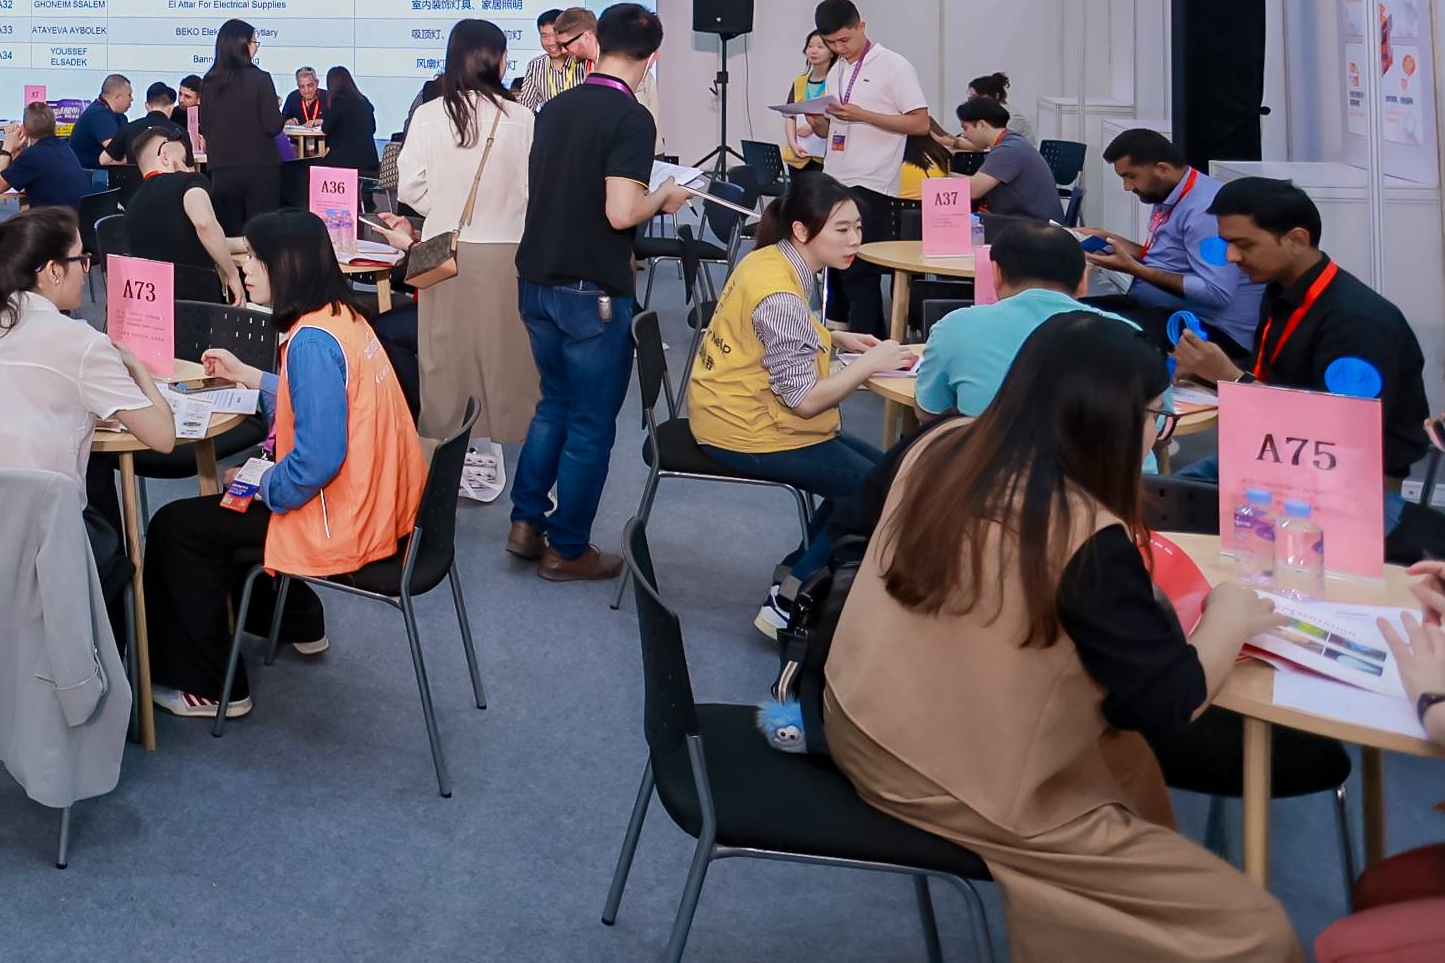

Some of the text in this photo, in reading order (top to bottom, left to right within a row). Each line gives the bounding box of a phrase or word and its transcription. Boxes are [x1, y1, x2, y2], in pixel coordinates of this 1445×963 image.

[34, 0, 106, 9] GHONEIM SSALEM
[178, 0, 196, 9] Attar
[198, 0, 211, 9] For
[213, 0, 250, 9] Electrical
[252, 0, 286, 11] Supplies
[411, 0, 523, 11] 室内装饰灯具、家居照明
[32, 26, 107, 35] ATAYEVA AYBOLEK
[175, 28, 199, 36] BEKO
[50, 47, 88, 56] YOUSSEF
[51, 57, 87, 66] ELSADEK
[321, 181, 345, 194] A36
[935, 192, 958, 206] A37
[122, 279, 156, 302] A73
[1256, 433, 1337, 471] A75
